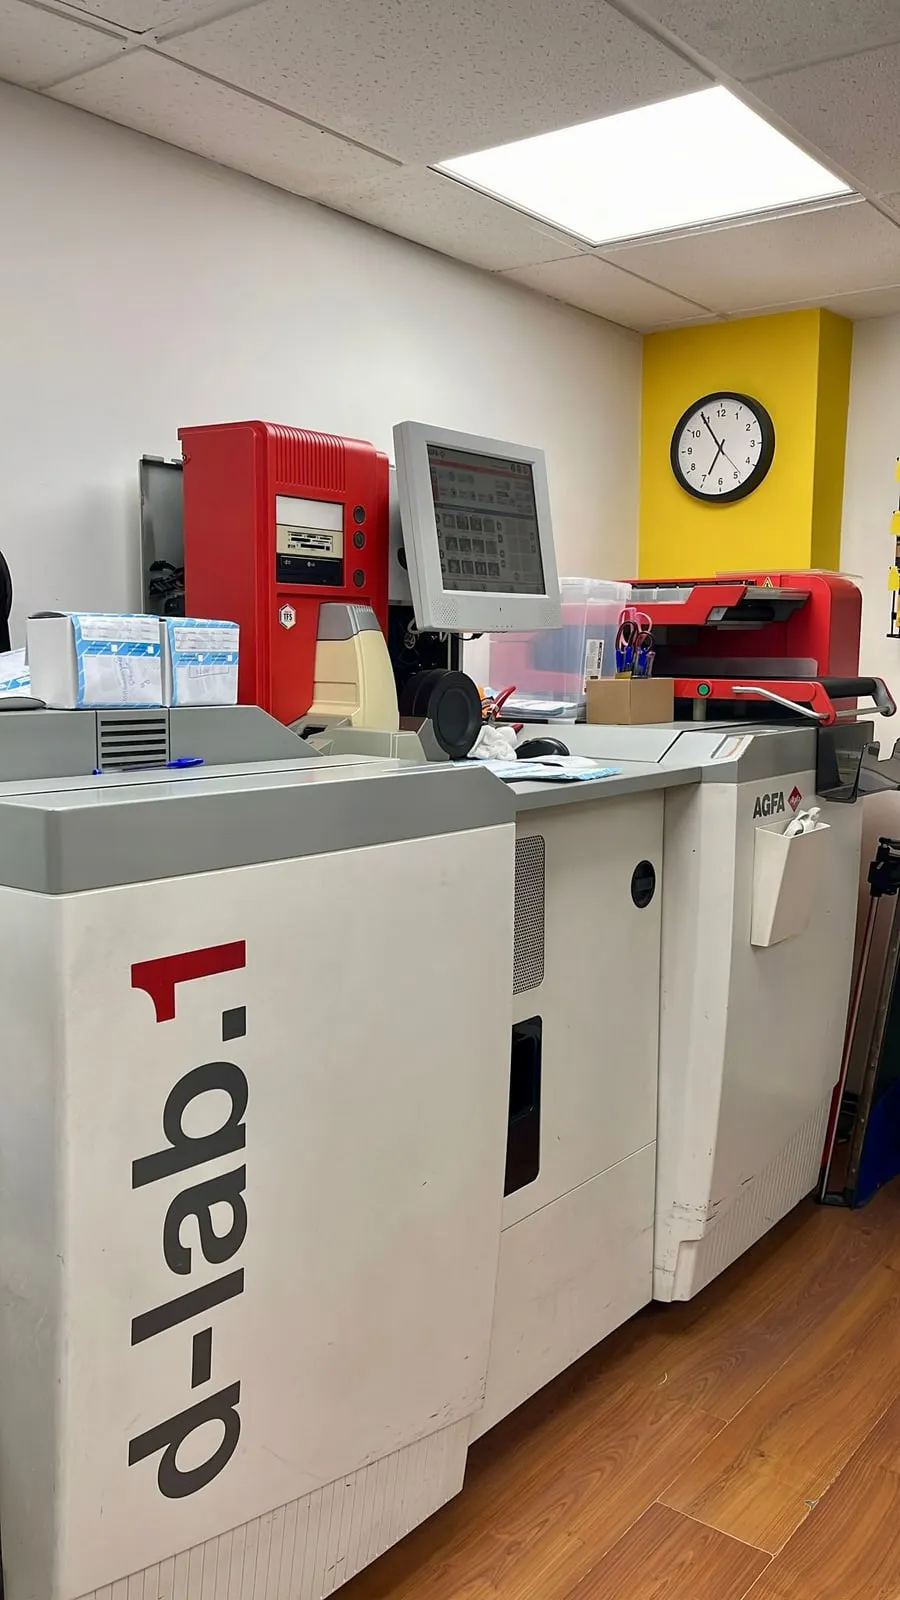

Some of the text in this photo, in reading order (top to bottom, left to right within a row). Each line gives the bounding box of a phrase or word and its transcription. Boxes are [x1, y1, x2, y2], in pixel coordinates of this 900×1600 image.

[716, 409, 726, 417] 12
[734, 412, 739, 420] 1
[745, 423, 751, 431] 2
[691, 430, 701, 438] 10
[749, 440, 755, 448] 3
[687, 447, 693, 455] 9
[745, 456, 751, 464] 4
[690, 463, 696, 471] 8
[701, 474, 707, 482] 7
[733, 471, 739, 479] 5
[718, 477, 723, 486] 6
[753, 792, 785, 819] AGFA
